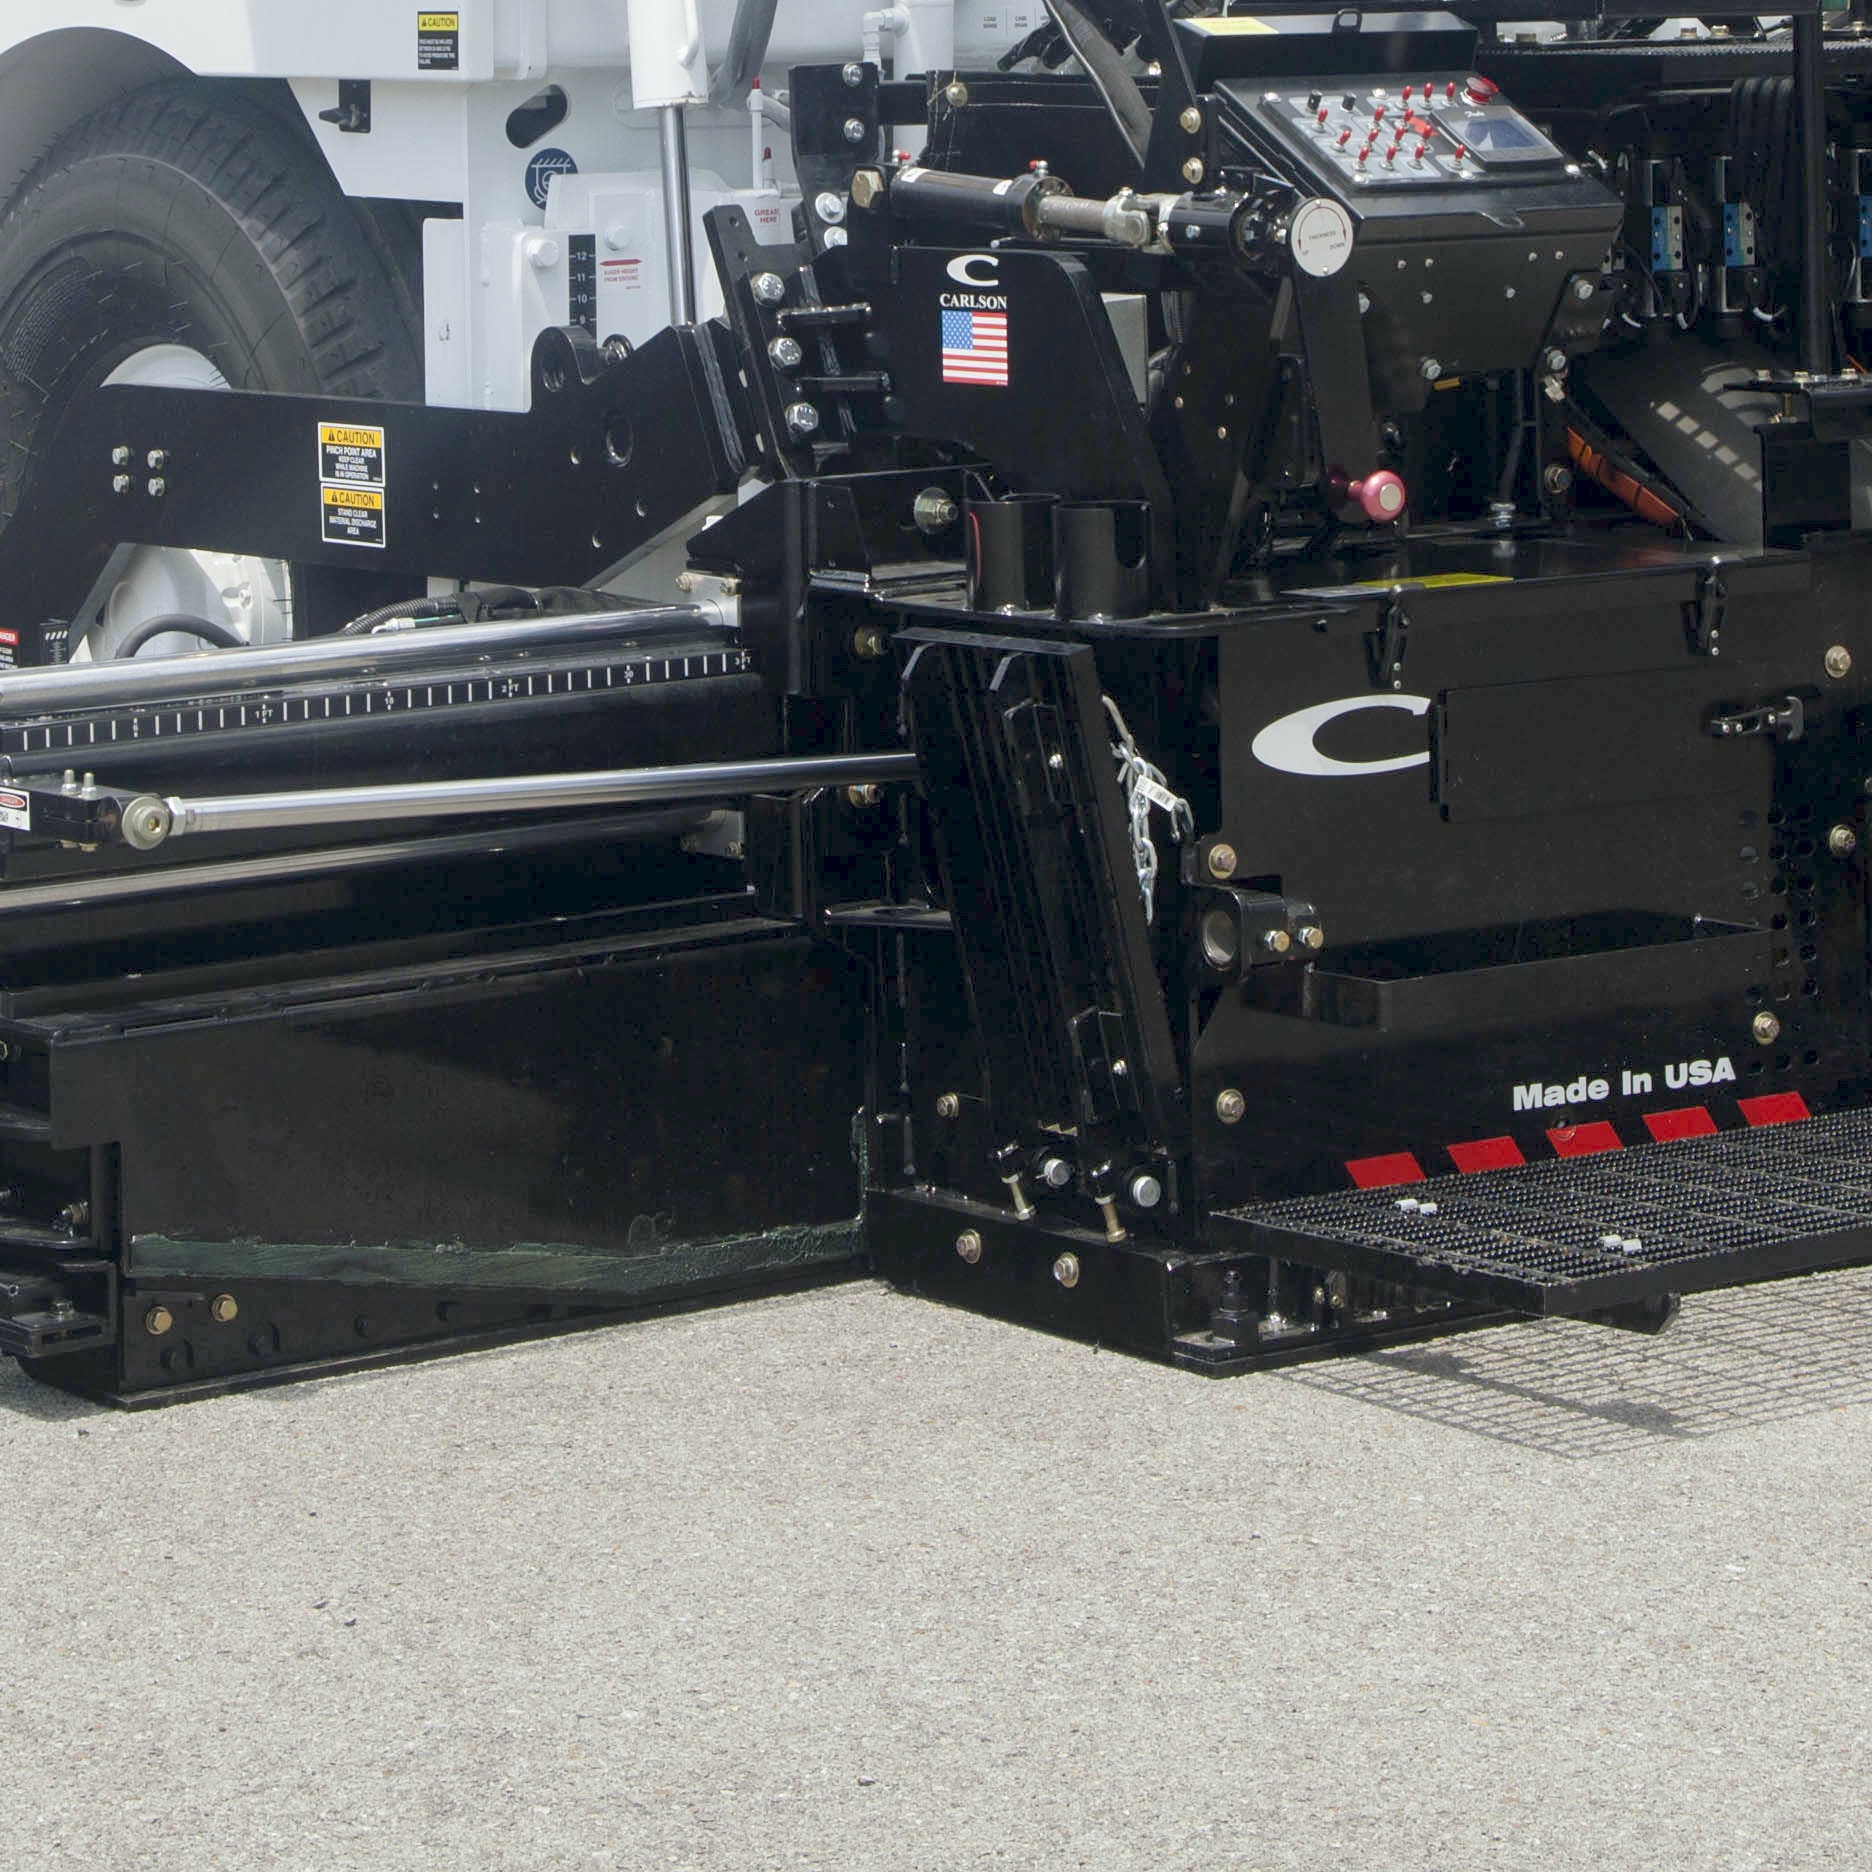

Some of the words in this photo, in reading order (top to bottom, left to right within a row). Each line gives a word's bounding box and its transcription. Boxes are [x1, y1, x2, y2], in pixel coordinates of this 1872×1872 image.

[428, 17, 456, 27] CAUTION
[577, 252, 587, 260] 12
[577, 295, 587, 303] 10
[940, 294, 1007, 309] CARLSON
[337, 430, 375, 445] CAUTION
[344, 446, 360, 457] POINT
[361, 448, 376, 458] AREA
[339, 492, 375, 506] CAUTION
[1513, 1076, 1609, 1112] Made
[1622, 1070, 1653, 1095] In
[1664, 1057, 1736, 1089] USA
